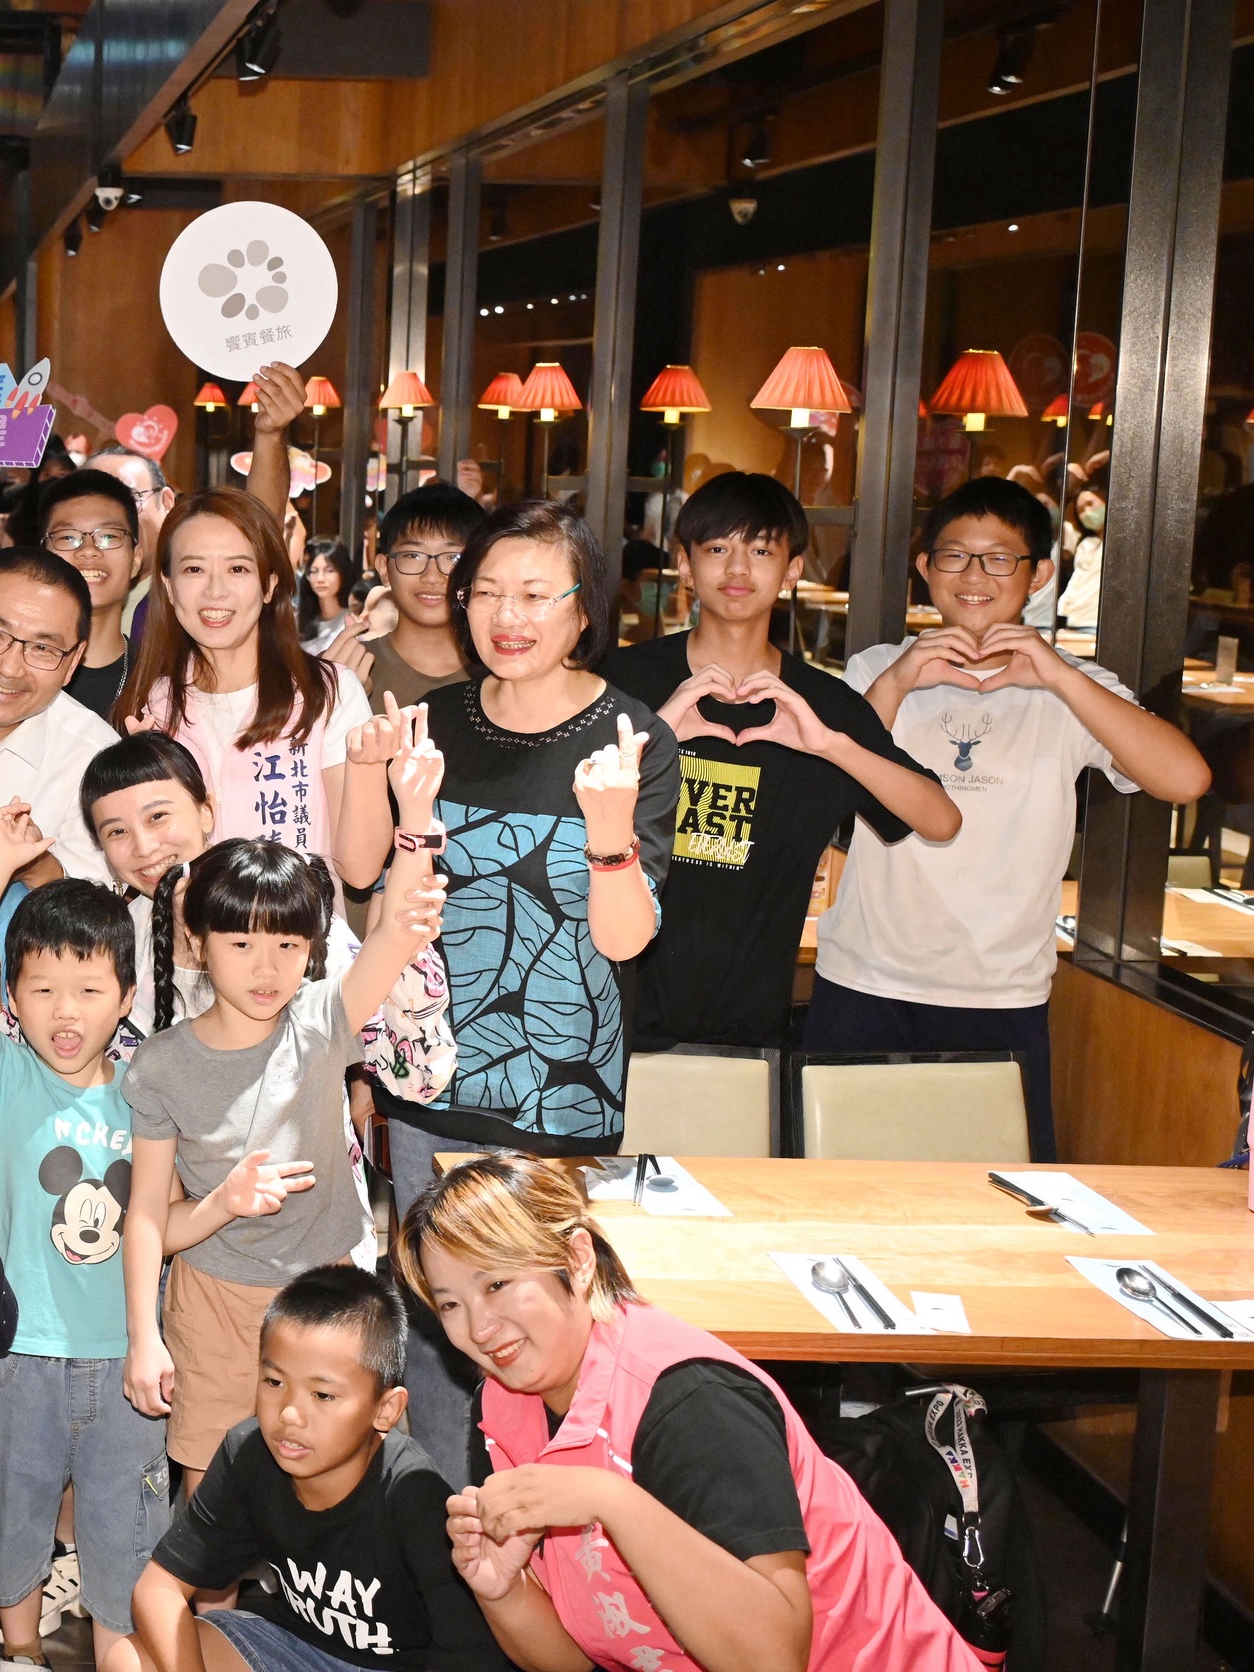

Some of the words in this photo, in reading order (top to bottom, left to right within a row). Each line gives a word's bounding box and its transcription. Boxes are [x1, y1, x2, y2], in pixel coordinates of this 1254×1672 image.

[225, 324, 293, 353] 饗賓餐旅
[968, 775, 1004, 786] JASON
[680, 776, 757, 816] VER
[929, 1400, 944, 1421] EXPO
[956, 1426, 969, 1456] HAKKA
[287, 1557, 382, 1617] WAY
